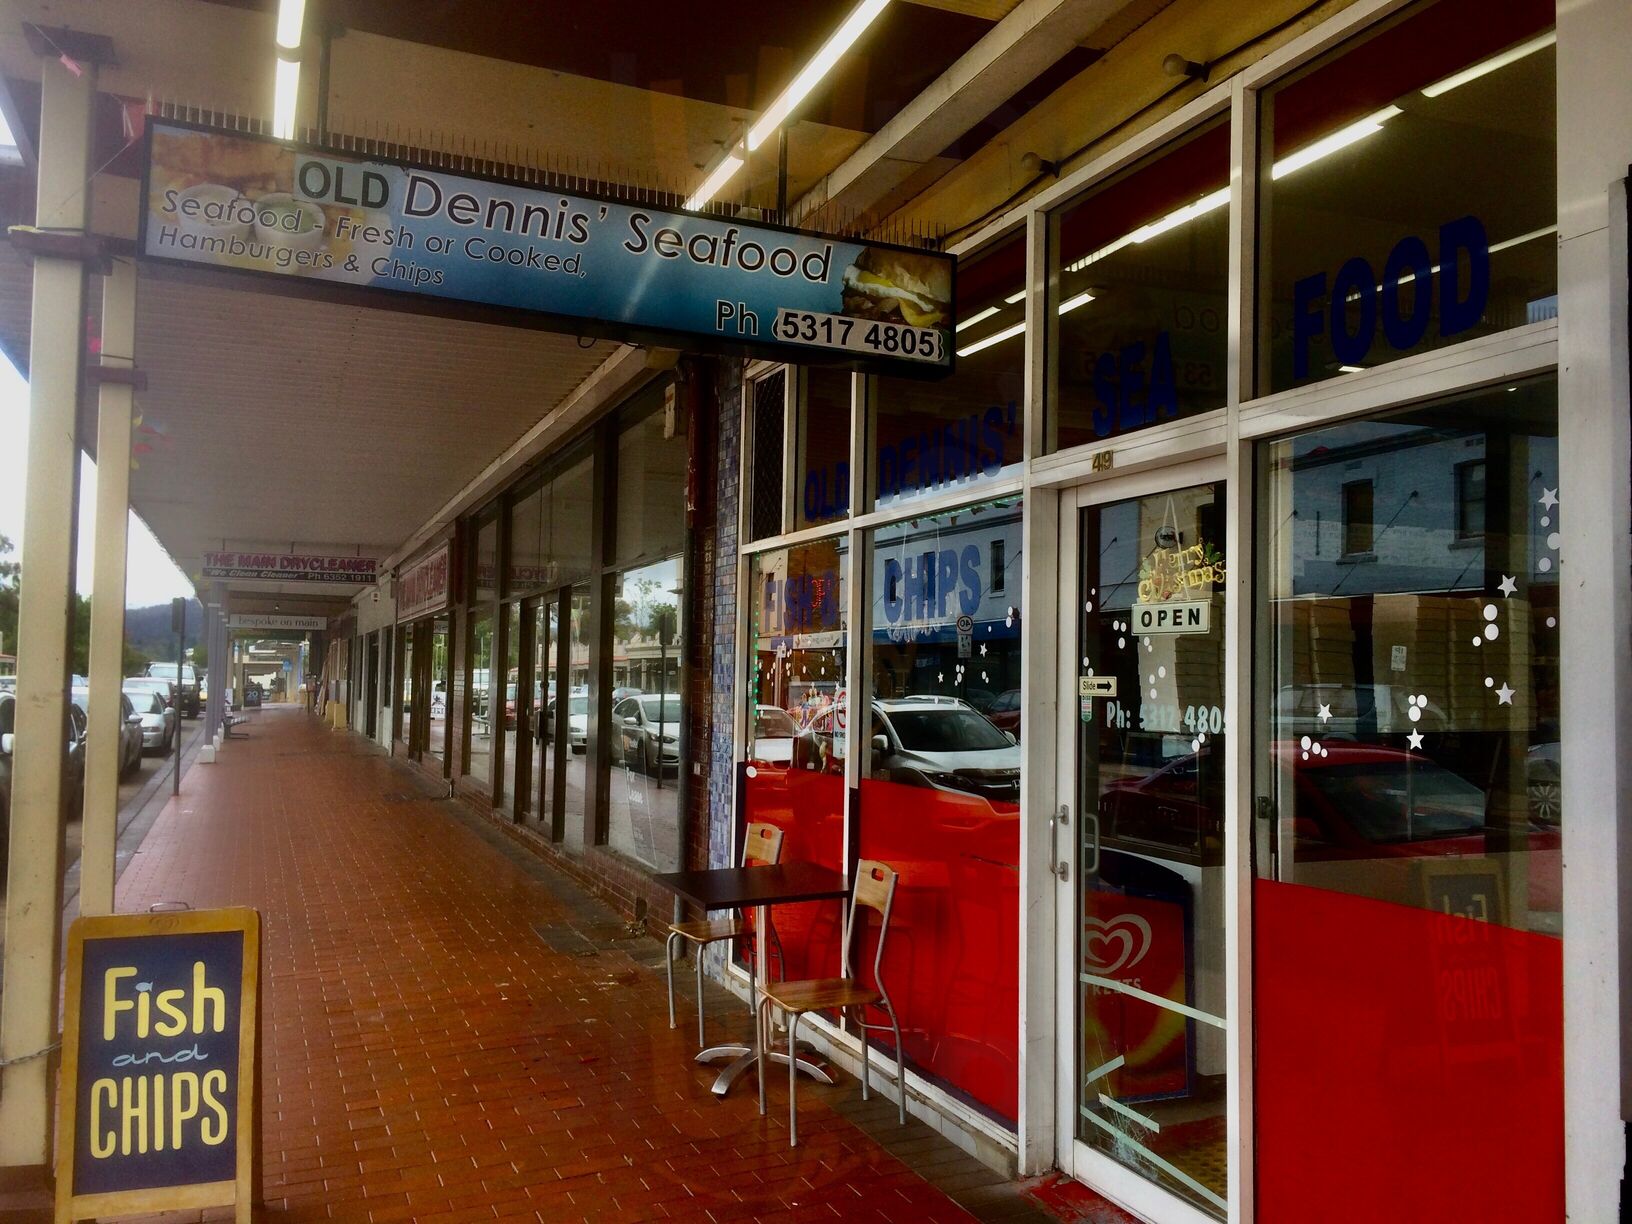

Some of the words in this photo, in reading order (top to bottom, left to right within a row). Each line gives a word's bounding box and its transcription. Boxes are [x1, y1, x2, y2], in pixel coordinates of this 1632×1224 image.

[162, 189, 303, 233] Seafood
[335, 215, 414, 249] Fresh
[425, 235, 455, 255] or
[464, 237, 587, 278] Cooked,
[298, 161, 390, 209] OLD
[404, 175, 607, 244] Dennis'
[623, 212, 833, 284] Seafood
[159, 225, 334, 270] Hamburgers
[343, 254, 360, 272] &
[371, 256, 445, 286] Chips
[1294, 215, 1490, 380] FOOD
[716, 299, 759, 336] Ph
[781, 314, 855, 346] 5317
[864, 323, 934, 358] 4805
[1092, 330, 1178, 438] SEA
[804, 461, 849, 522] OLD
[1092, 450, 1111, 472] 49
[204, 553, 234, 567] THE
[238, 554, 276, 569] MAIN
[884, 544, 981, 625] CHIPS
[295, 617, 319, 627] main
[1141, 608, 1200, 628] OPEN
[1082, 680, 1096, 690] Slide
[1106, 700, 1131, 729] Ph:
[1184, 704, 1225, 734] 480
[103, 961, 226, 1041] Fish
[112, 1044, 209, 1067] and
[90, 1069, 228, 1159] CHIPS
